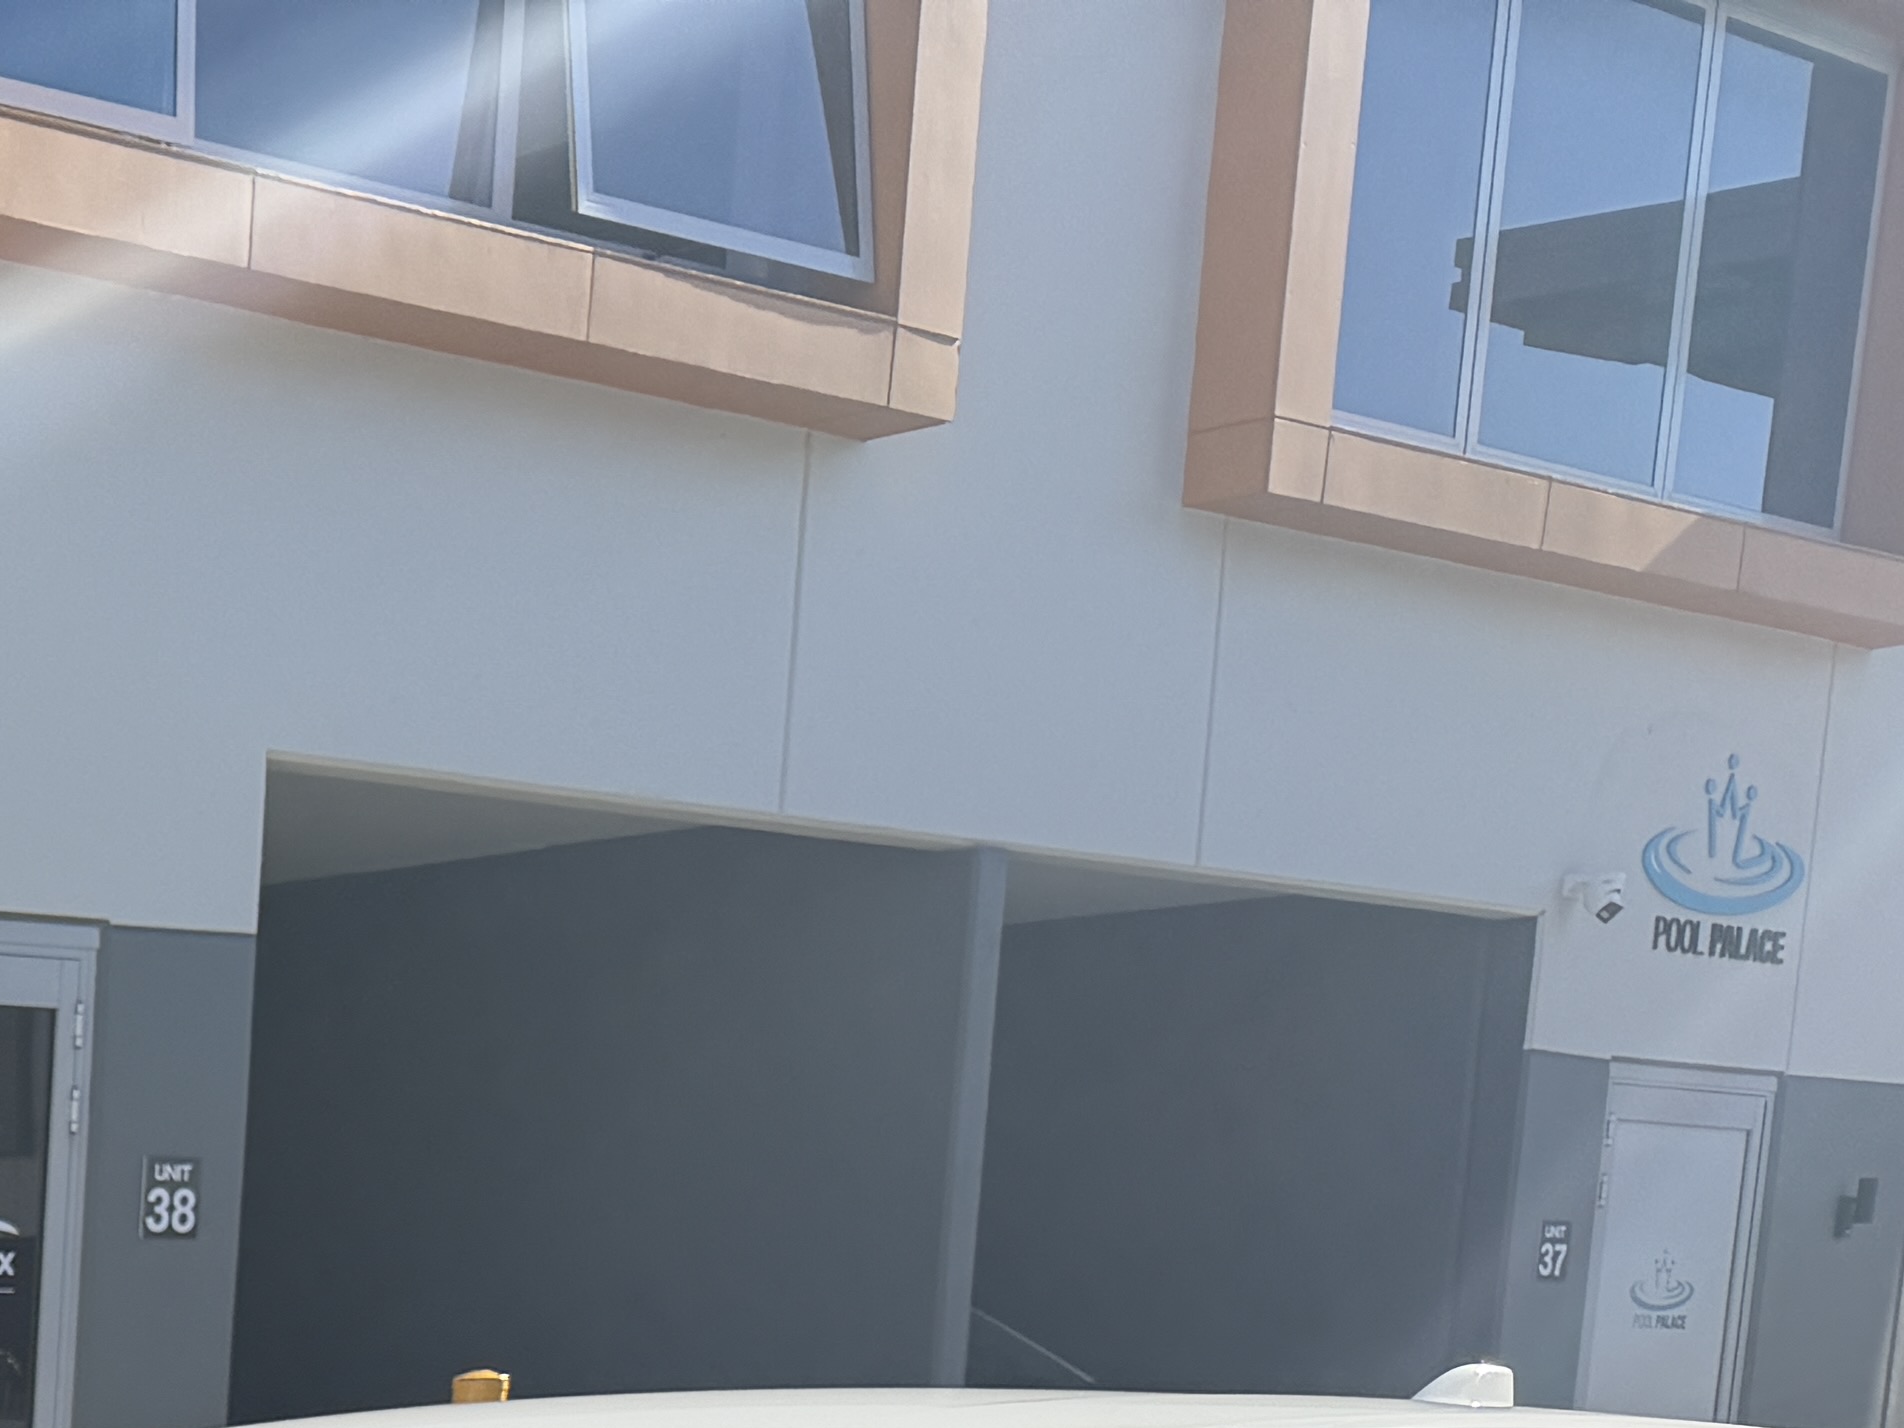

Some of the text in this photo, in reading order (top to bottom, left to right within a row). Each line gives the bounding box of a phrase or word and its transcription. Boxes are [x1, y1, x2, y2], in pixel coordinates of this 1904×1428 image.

[1651, 914, 1787, 965] POOL PALACE
[154, 1162, 193, 1183] UNIT
[144, 1186, 197, 1235] 38
[1538, 1242, 1569, 1277] 37
